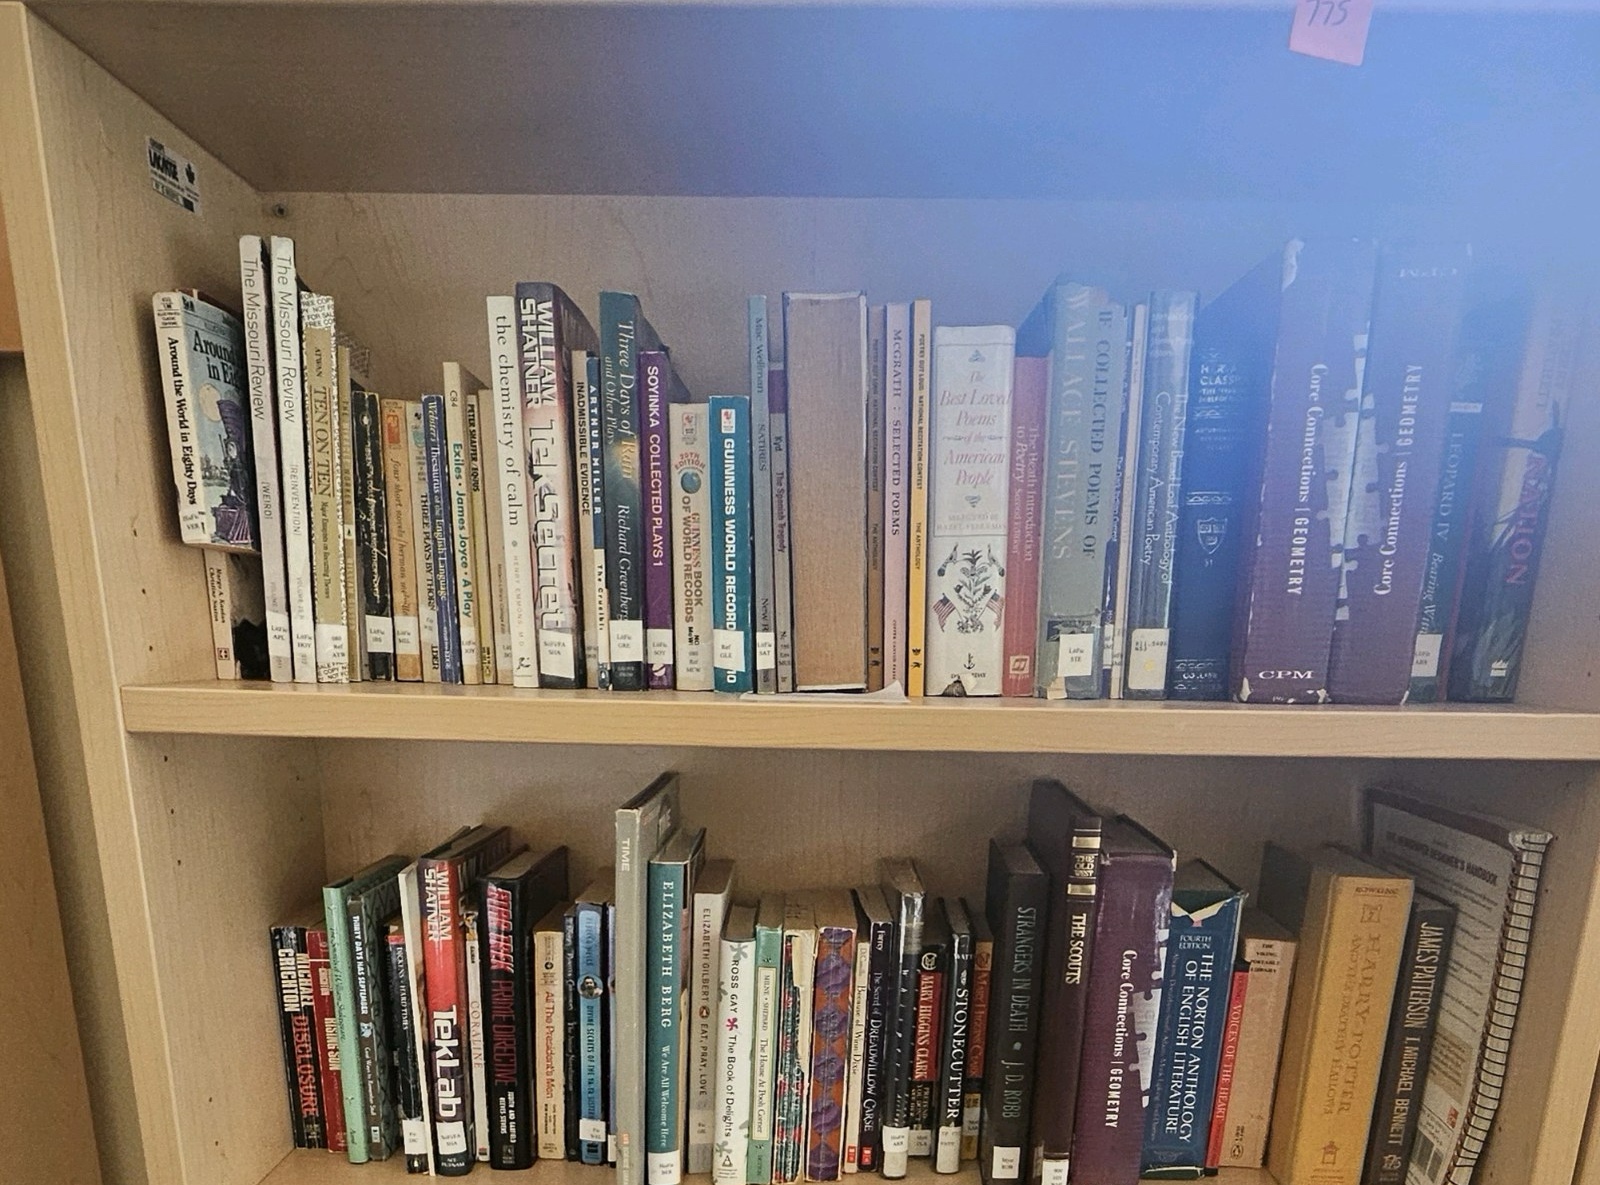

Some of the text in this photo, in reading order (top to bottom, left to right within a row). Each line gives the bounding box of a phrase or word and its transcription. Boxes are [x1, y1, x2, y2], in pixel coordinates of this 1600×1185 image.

[243, 257, 266, 420] The Missouri Review
[276, 256, 297, 423] The Missouri Review
[520, 298, 541, 408] SHATNER
[536, 301, 558, 407] WILLIAM
[618, 321, 634, 415] Three Days
[168, 337, 197, 505] Around the World in Eighty Days
[314, 387, 331, 497] TEN ON TEN
[496, 315, 523, 526] the chemistry of calm
[577, 382, 590, 515] INADMISSIBLE EVIDENCE
[589, 385, 601, 514] ARTHUR MILLER
[1085, 340, 1111, 526] COLLECTED POEMS
[1395, 365, 1423, 446] GEOMETRY
[648, 366, 663, 560] SOYINKA COLLECTED PLAYS
[724, 438, 736, 571] GUINNESS WORLD
[891, 420, 901, 536] SELECTED POEMS
[1287, 363, 1327, 595] Core Connections GEOMETRY
[453, 443, 473, 618] Exiles James Joyce A Play
[618, 505, 633, 554] Richard
[681, 496, 694, 624] OF WORLD RECORDS
[1140, 534, 1159, 566] Poetry
[1374, 559, 1394, 596] Core
[693, 571, 703, 607] BOOK
[1258, 670, 1315, 680] CPM
[424, 868, 439, 942] SHATNER
[622, 838, 631, 872] TIME
[278, 948, 300, 1012] CRICHTON
[296, 953, 314, 1007] MICHAEL
[352, 915, 368, 1015] THIRTY DAYS HAS SEPTEMBER
[661, 881, 674, 977] ELIZABETH
[1066, 913, 1087, 985] THE SCOUTS
[470, 1001, 482, 1068] CORALINE
[660, 985, 674, 1028] BERG
[699, 908, 711, 1096] ELIZABETH LOVE
[722, 960, 740, 1137] ROSS GAY The Book of Delights
[915, 973, 934, 1080] MARY HIGGINS CLARK
[947, 988, 970, 1119] STONECUTTER
[1002, 907, 1036, 1119] STRANGERS IN DEATH ROBB
[1105, 949, 1138, 1128] Core Connections GEOMETRY
[1165, 961, 1198, 1134] OF ENGLISH LITERATURE
[1179, 952, 1214, 1142] THE NORTON ANTHOLOGY
[1388, 922, 1444, 1145] JAMES PATTERSON MICHAEL BENNETT
[291, 1013, 318, 1118] DISCLOSURE
[433, 1005, 461, 1117] TekLab
[661, 1089, 670, 1127] Welcome
[757, 1040, 768, 1133] The House Pooh Corner
[863, 1018, 882, 1132] DREADWILLOW CARSE
[660, 1128, 670, 1147] Here
